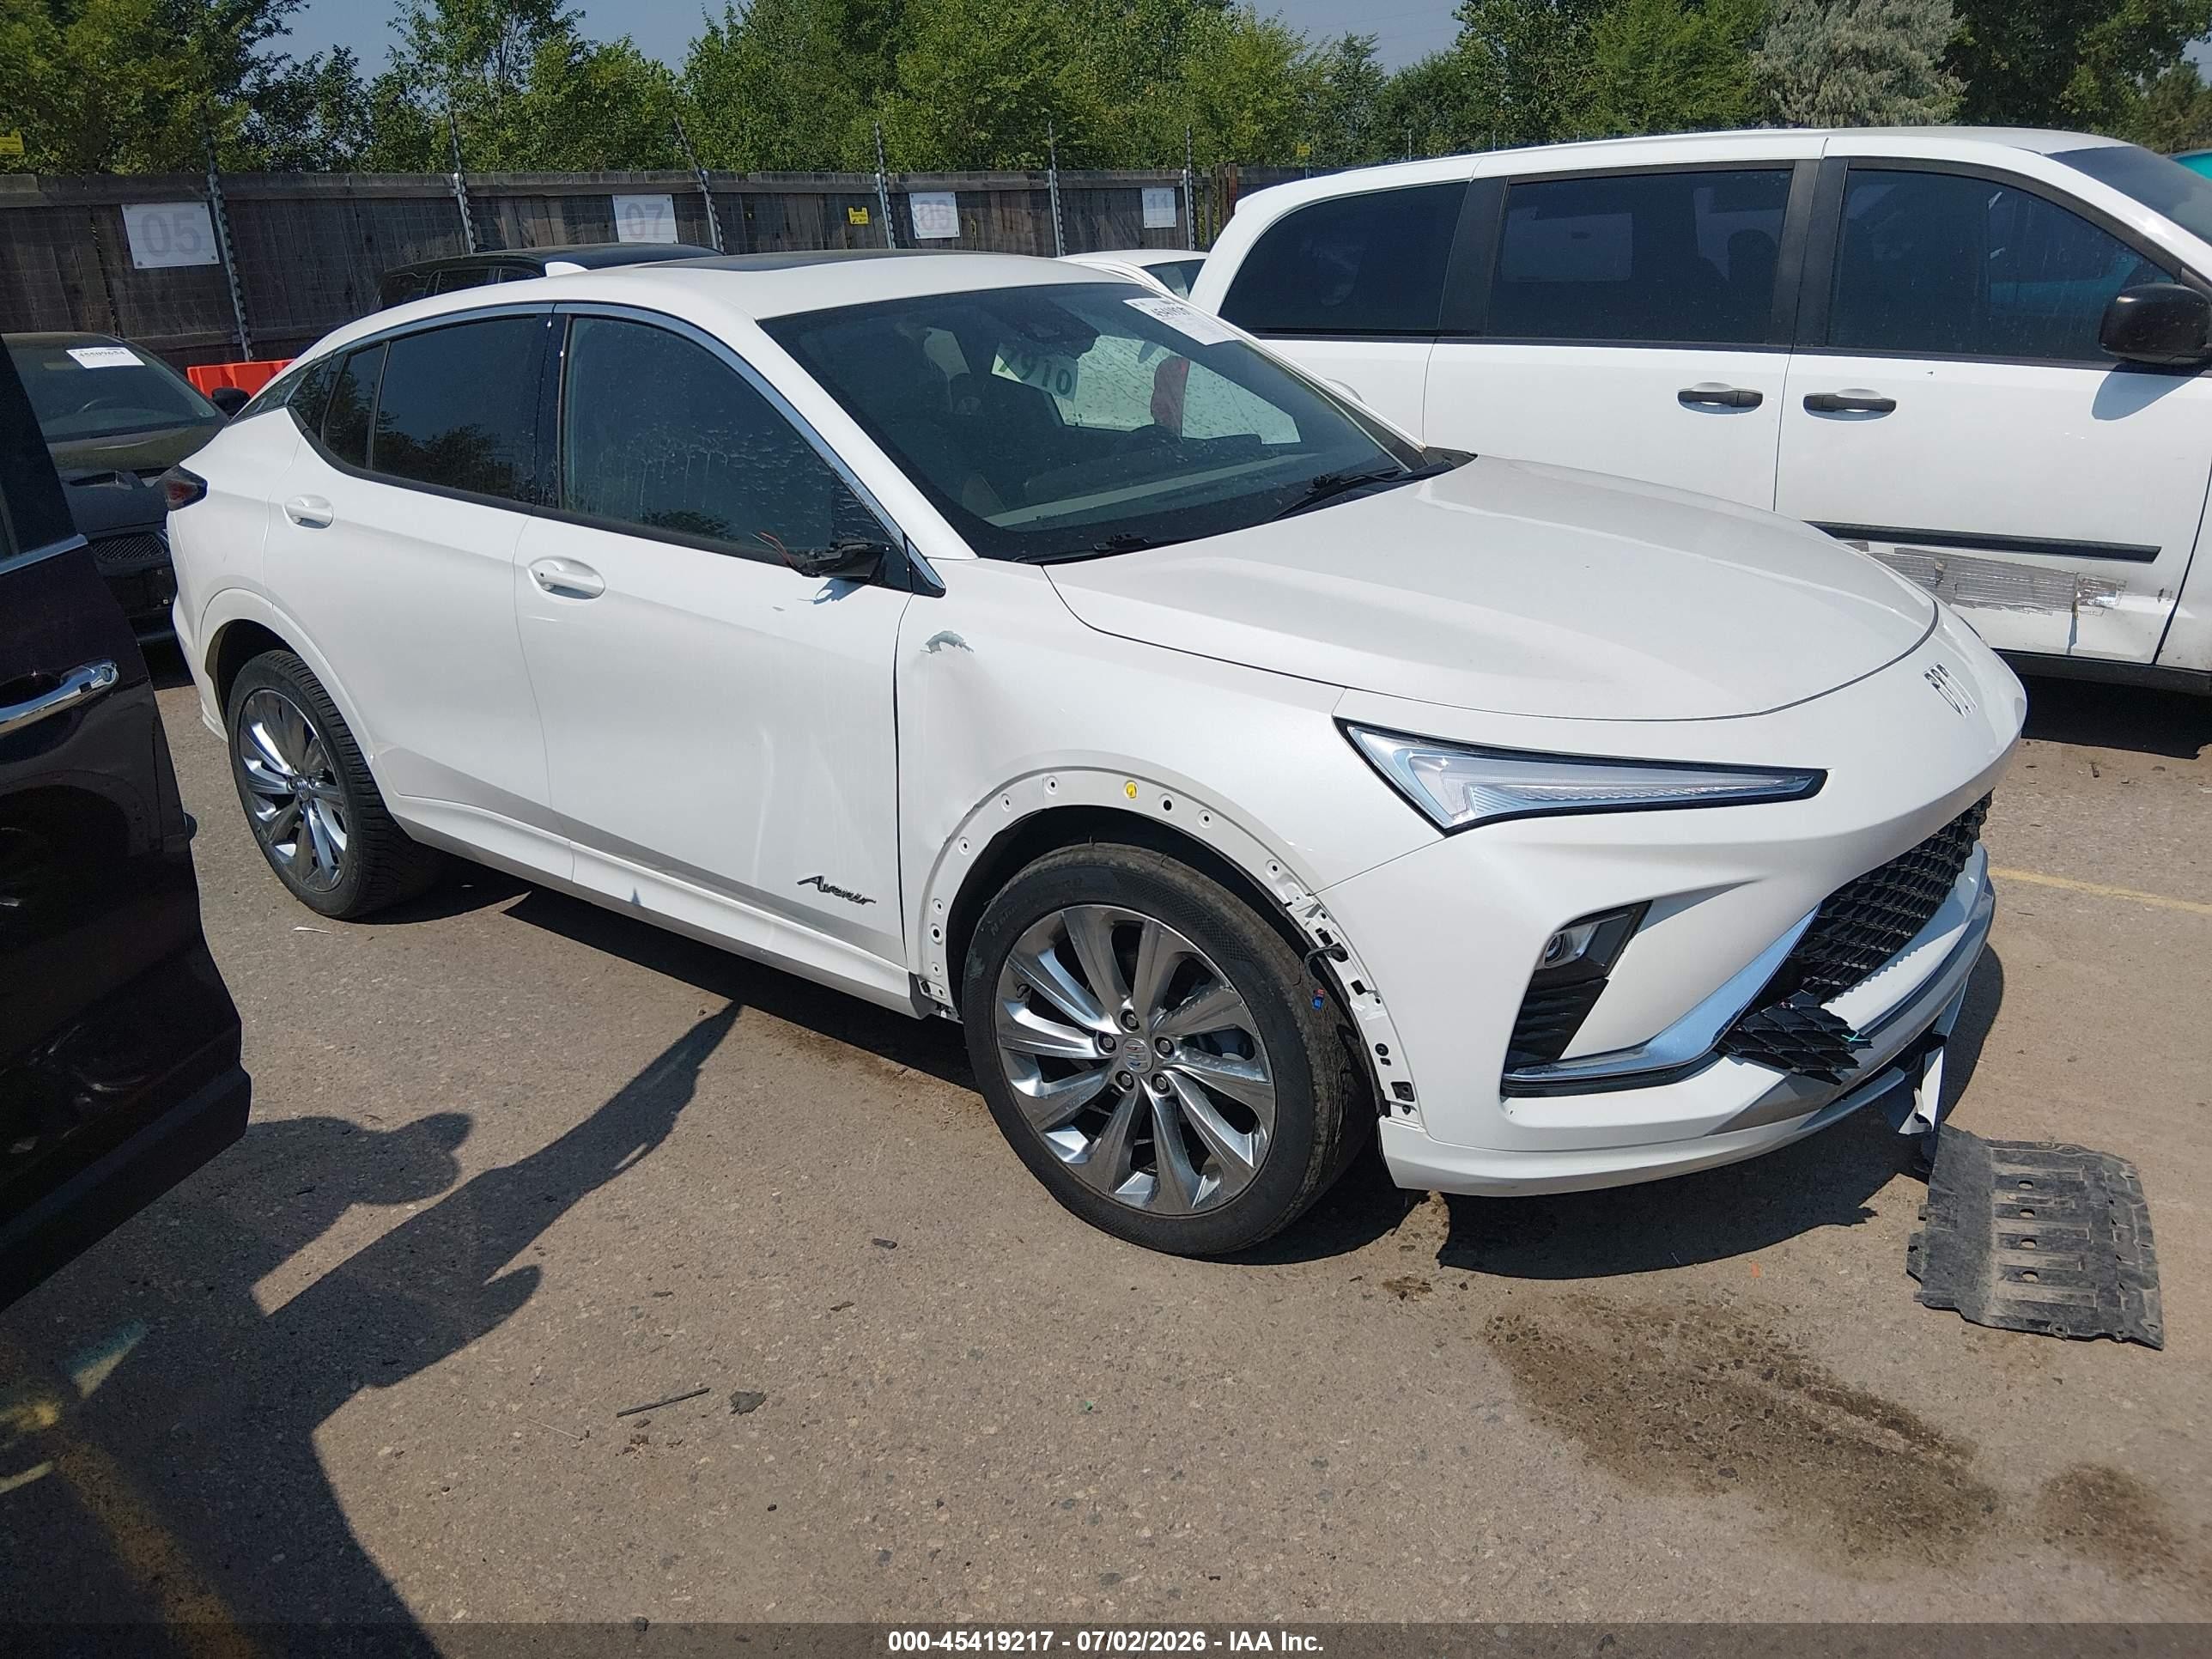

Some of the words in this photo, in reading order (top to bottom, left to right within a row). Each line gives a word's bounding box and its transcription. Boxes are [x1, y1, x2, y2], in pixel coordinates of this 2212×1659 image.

[142, 212, 201, 257] 05
[625, 202, 665, 240] 07
[797, 875, 877, 905] Avenir
